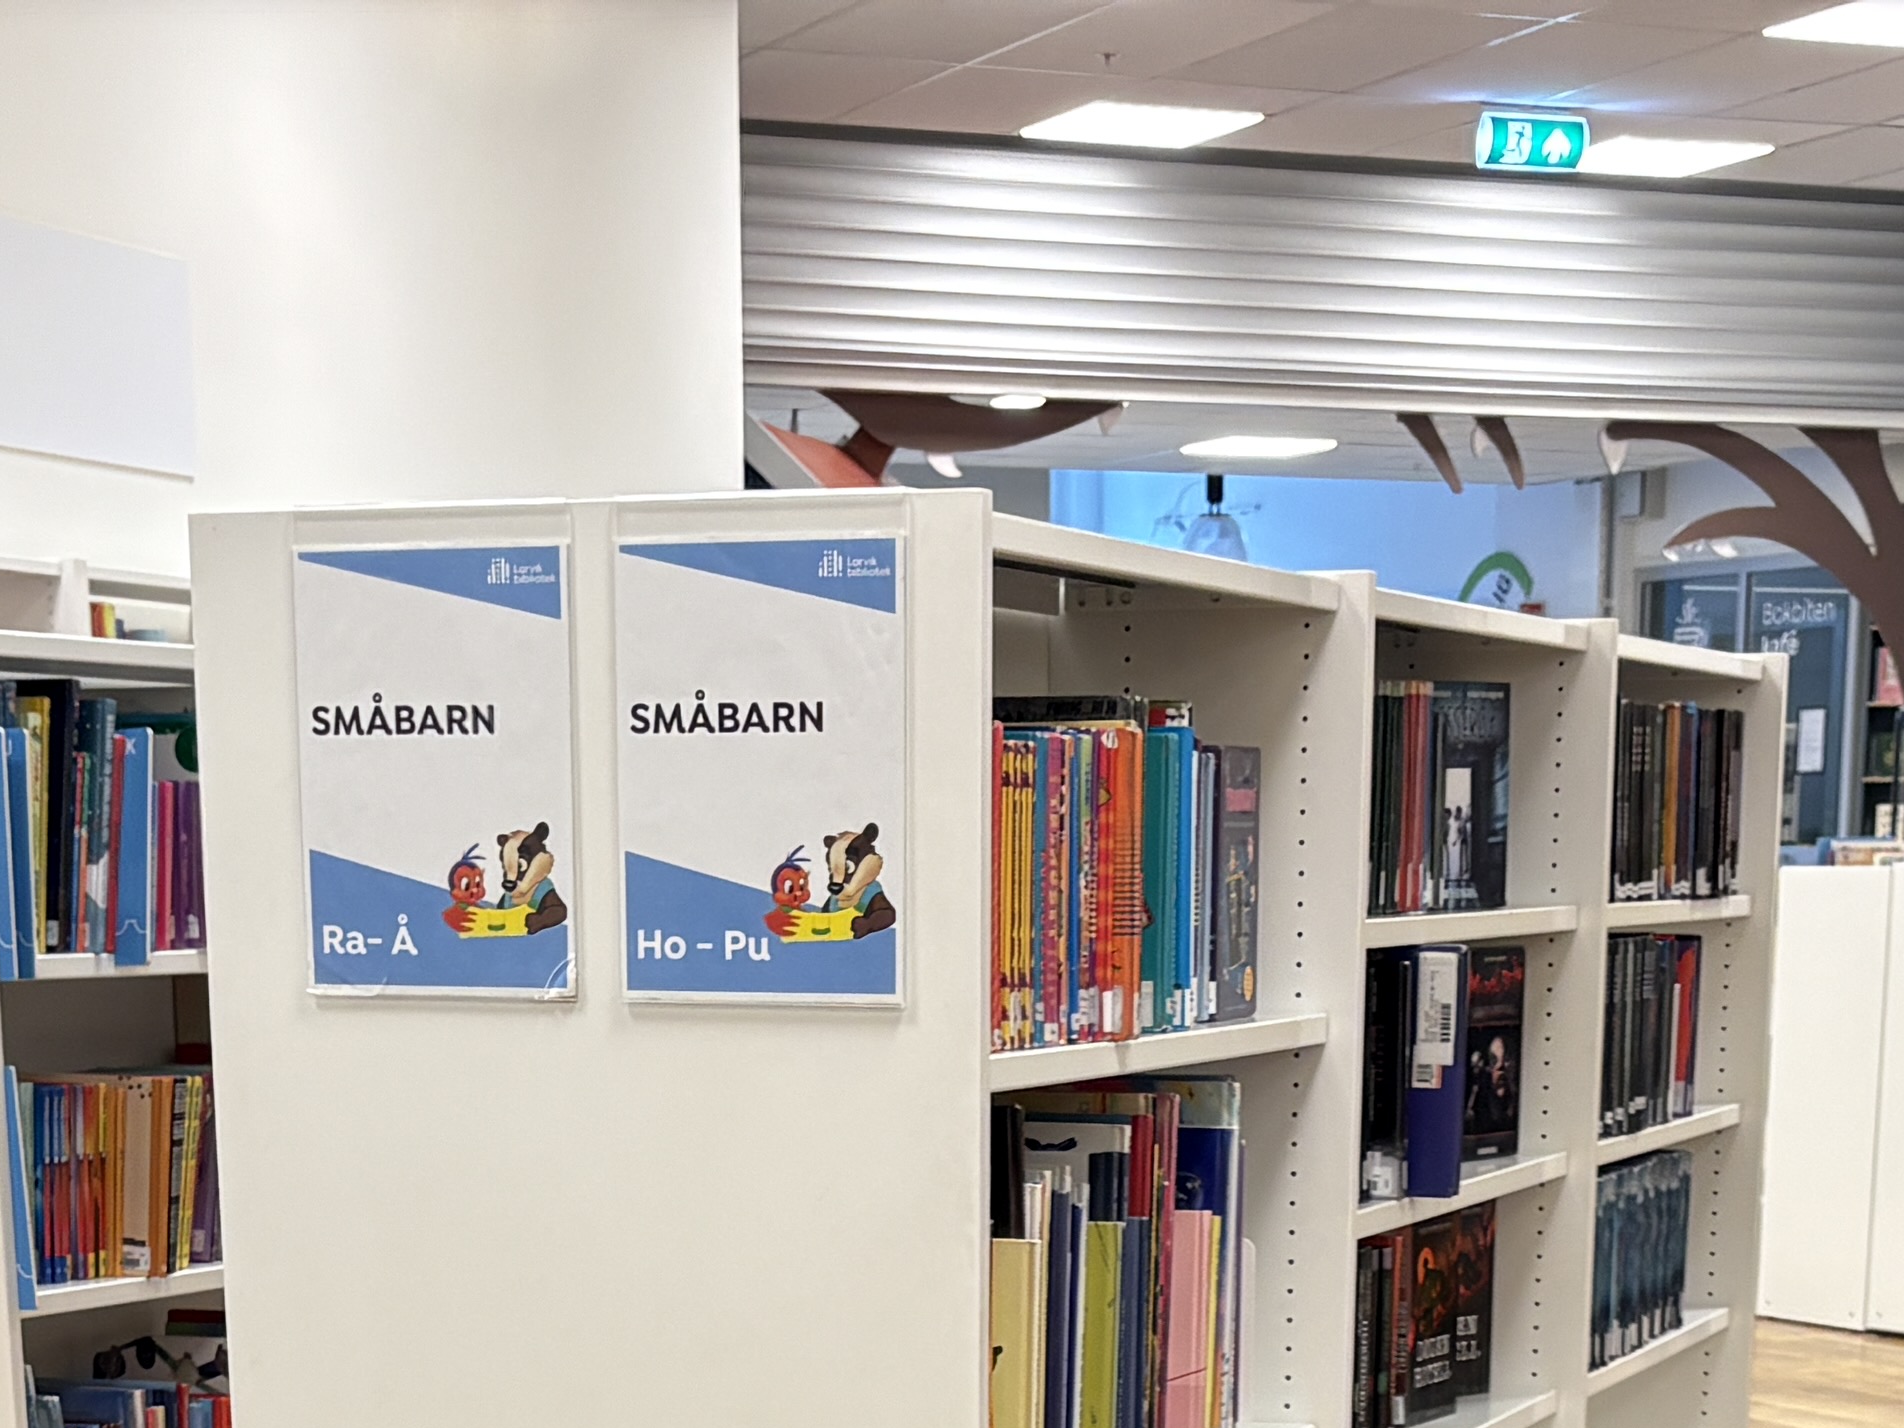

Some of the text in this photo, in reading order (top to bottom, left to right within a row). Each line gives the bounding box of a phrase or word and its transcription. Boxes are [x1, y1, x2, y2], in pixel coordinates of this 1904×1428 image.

[311, 692, 495, 736] SMÅBARN
[630, 689, 824, 735] SMÅBARN
[391, 913, 419, 956] Å
[637, 929, 687, 960] Ho
[724, 930, 771, 961] Pu
